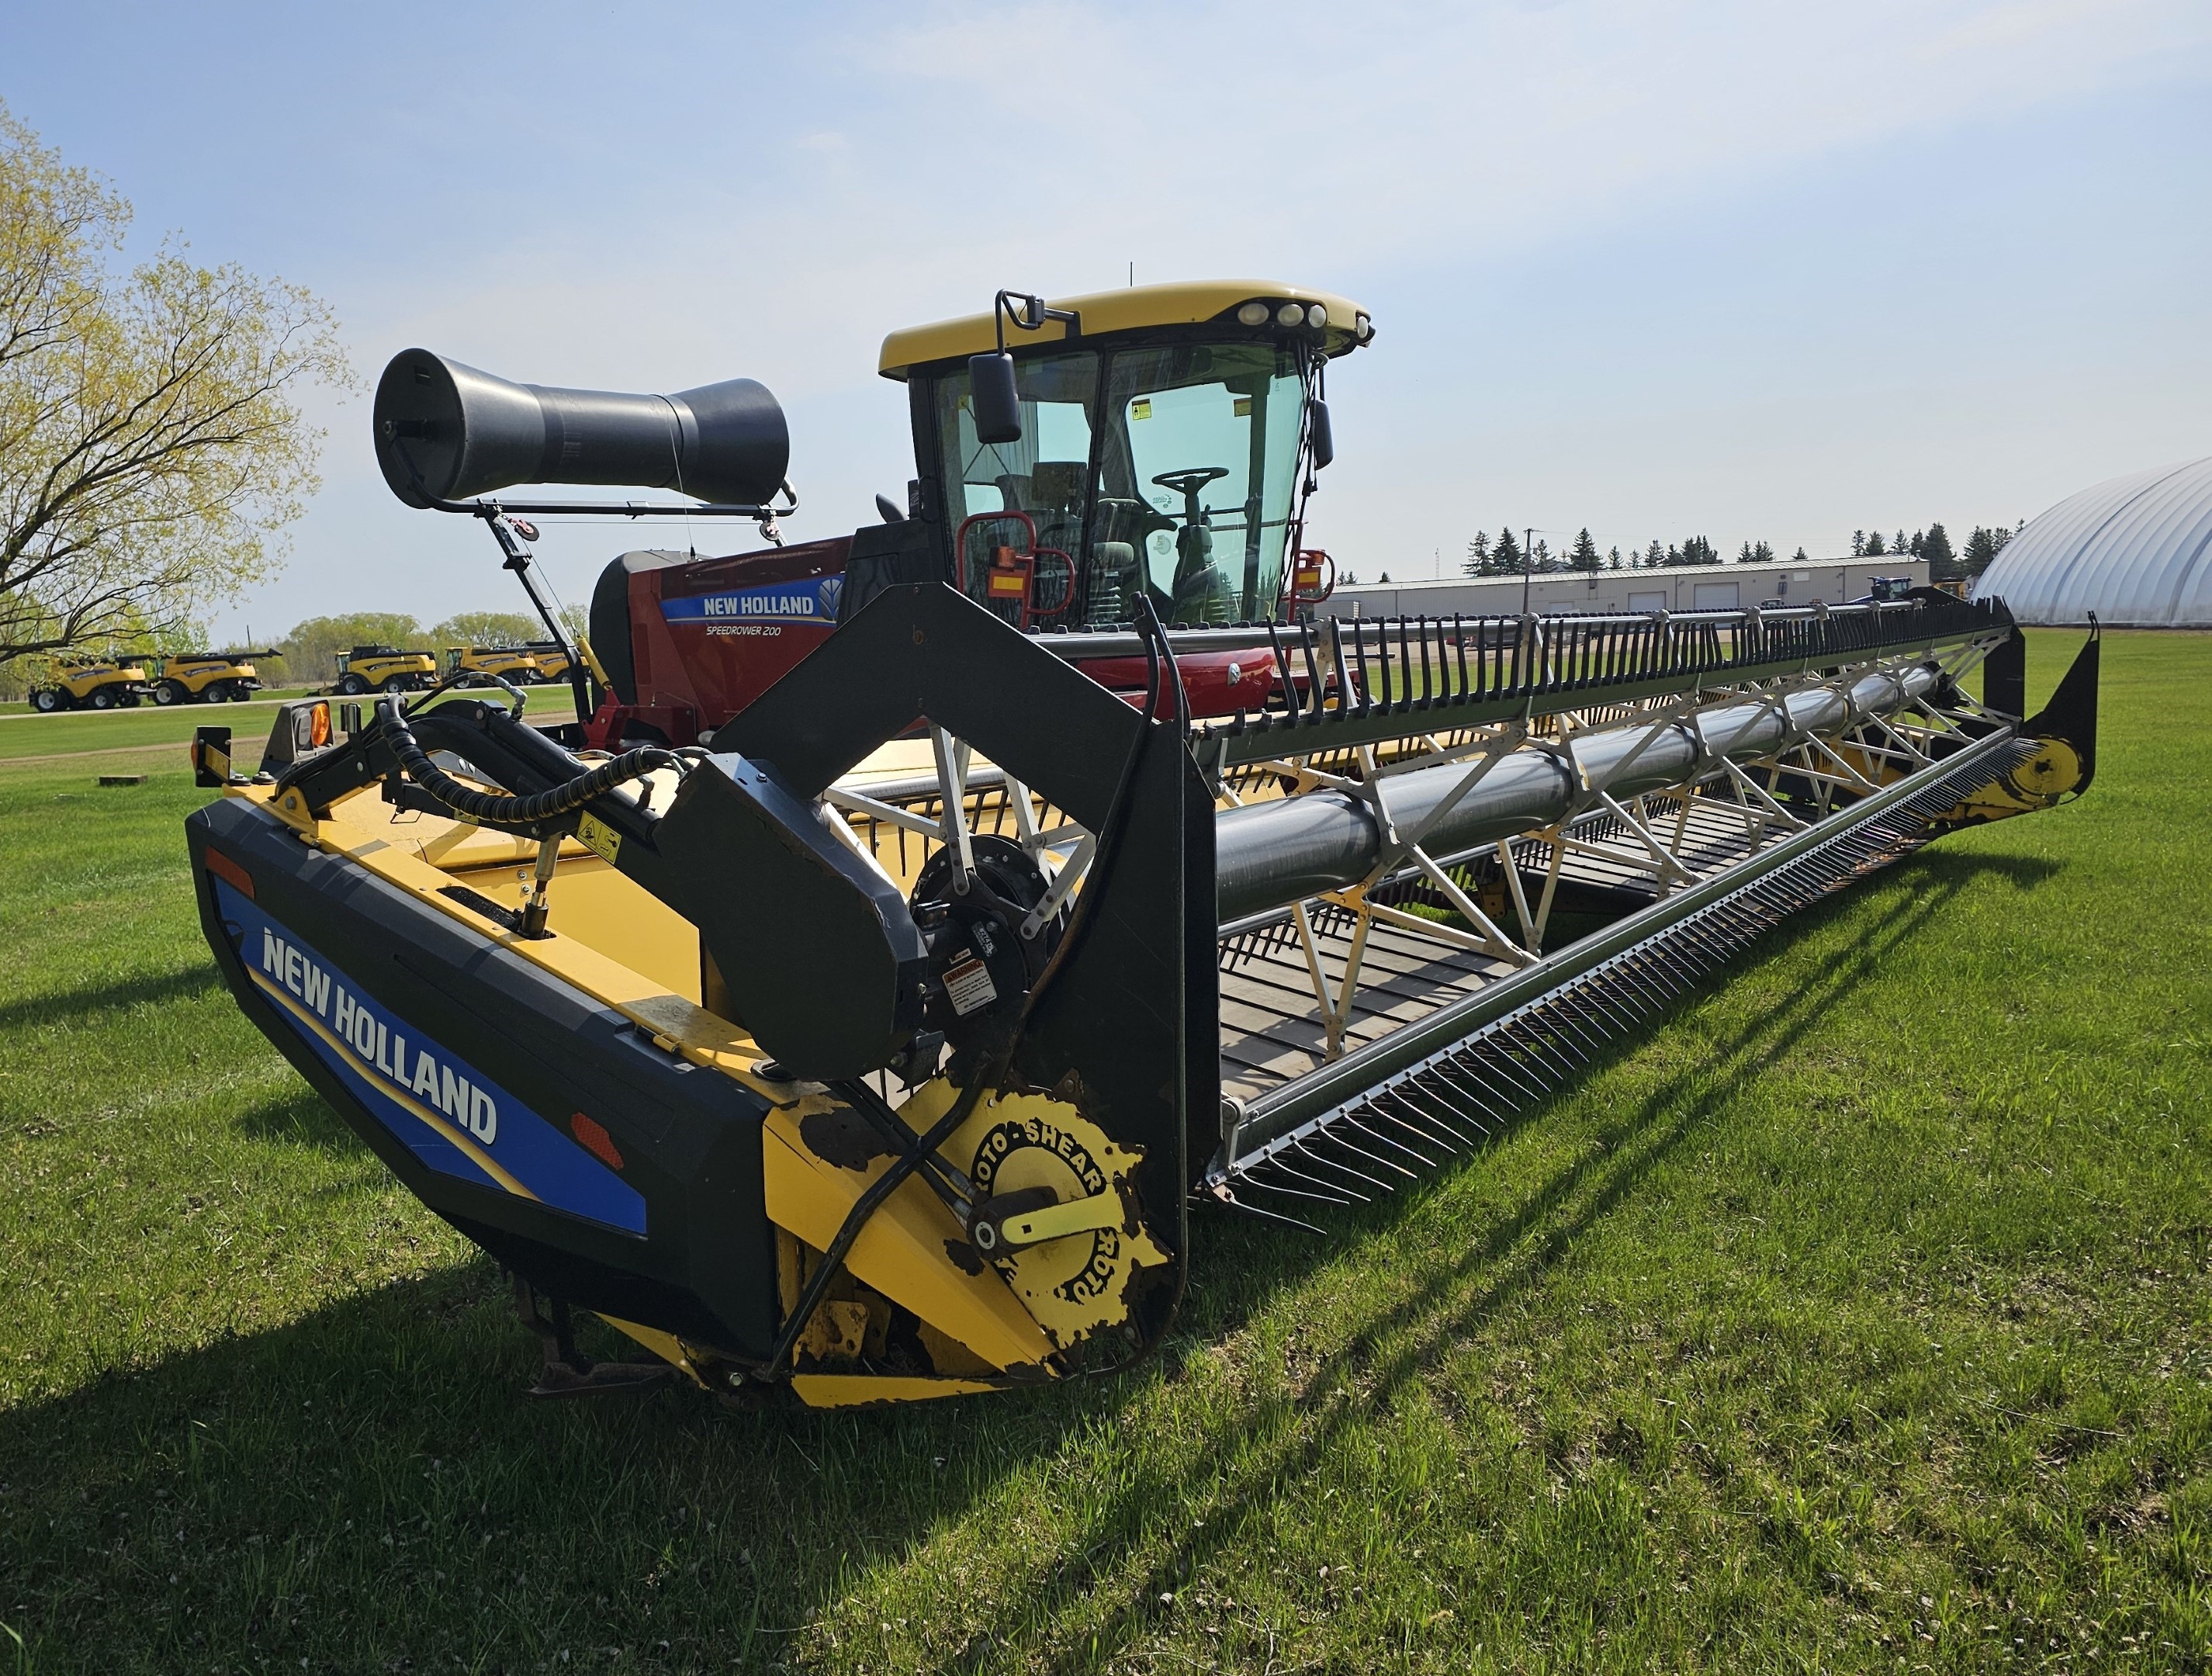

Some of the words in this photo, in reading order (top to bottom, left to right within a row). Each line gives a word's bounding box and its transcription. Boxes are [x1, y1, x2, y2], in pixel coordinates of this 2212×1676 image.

[704, 597, 738, 615] NEW
[741, 596, 814, 615] HOLLAND
[706, 625, 762, 635] SPEEDROWER
[763, 626, 781, 636] 200
[263, 926, 331, 1018] NEW
[334, 985, 497, 1145] HOLLAND
